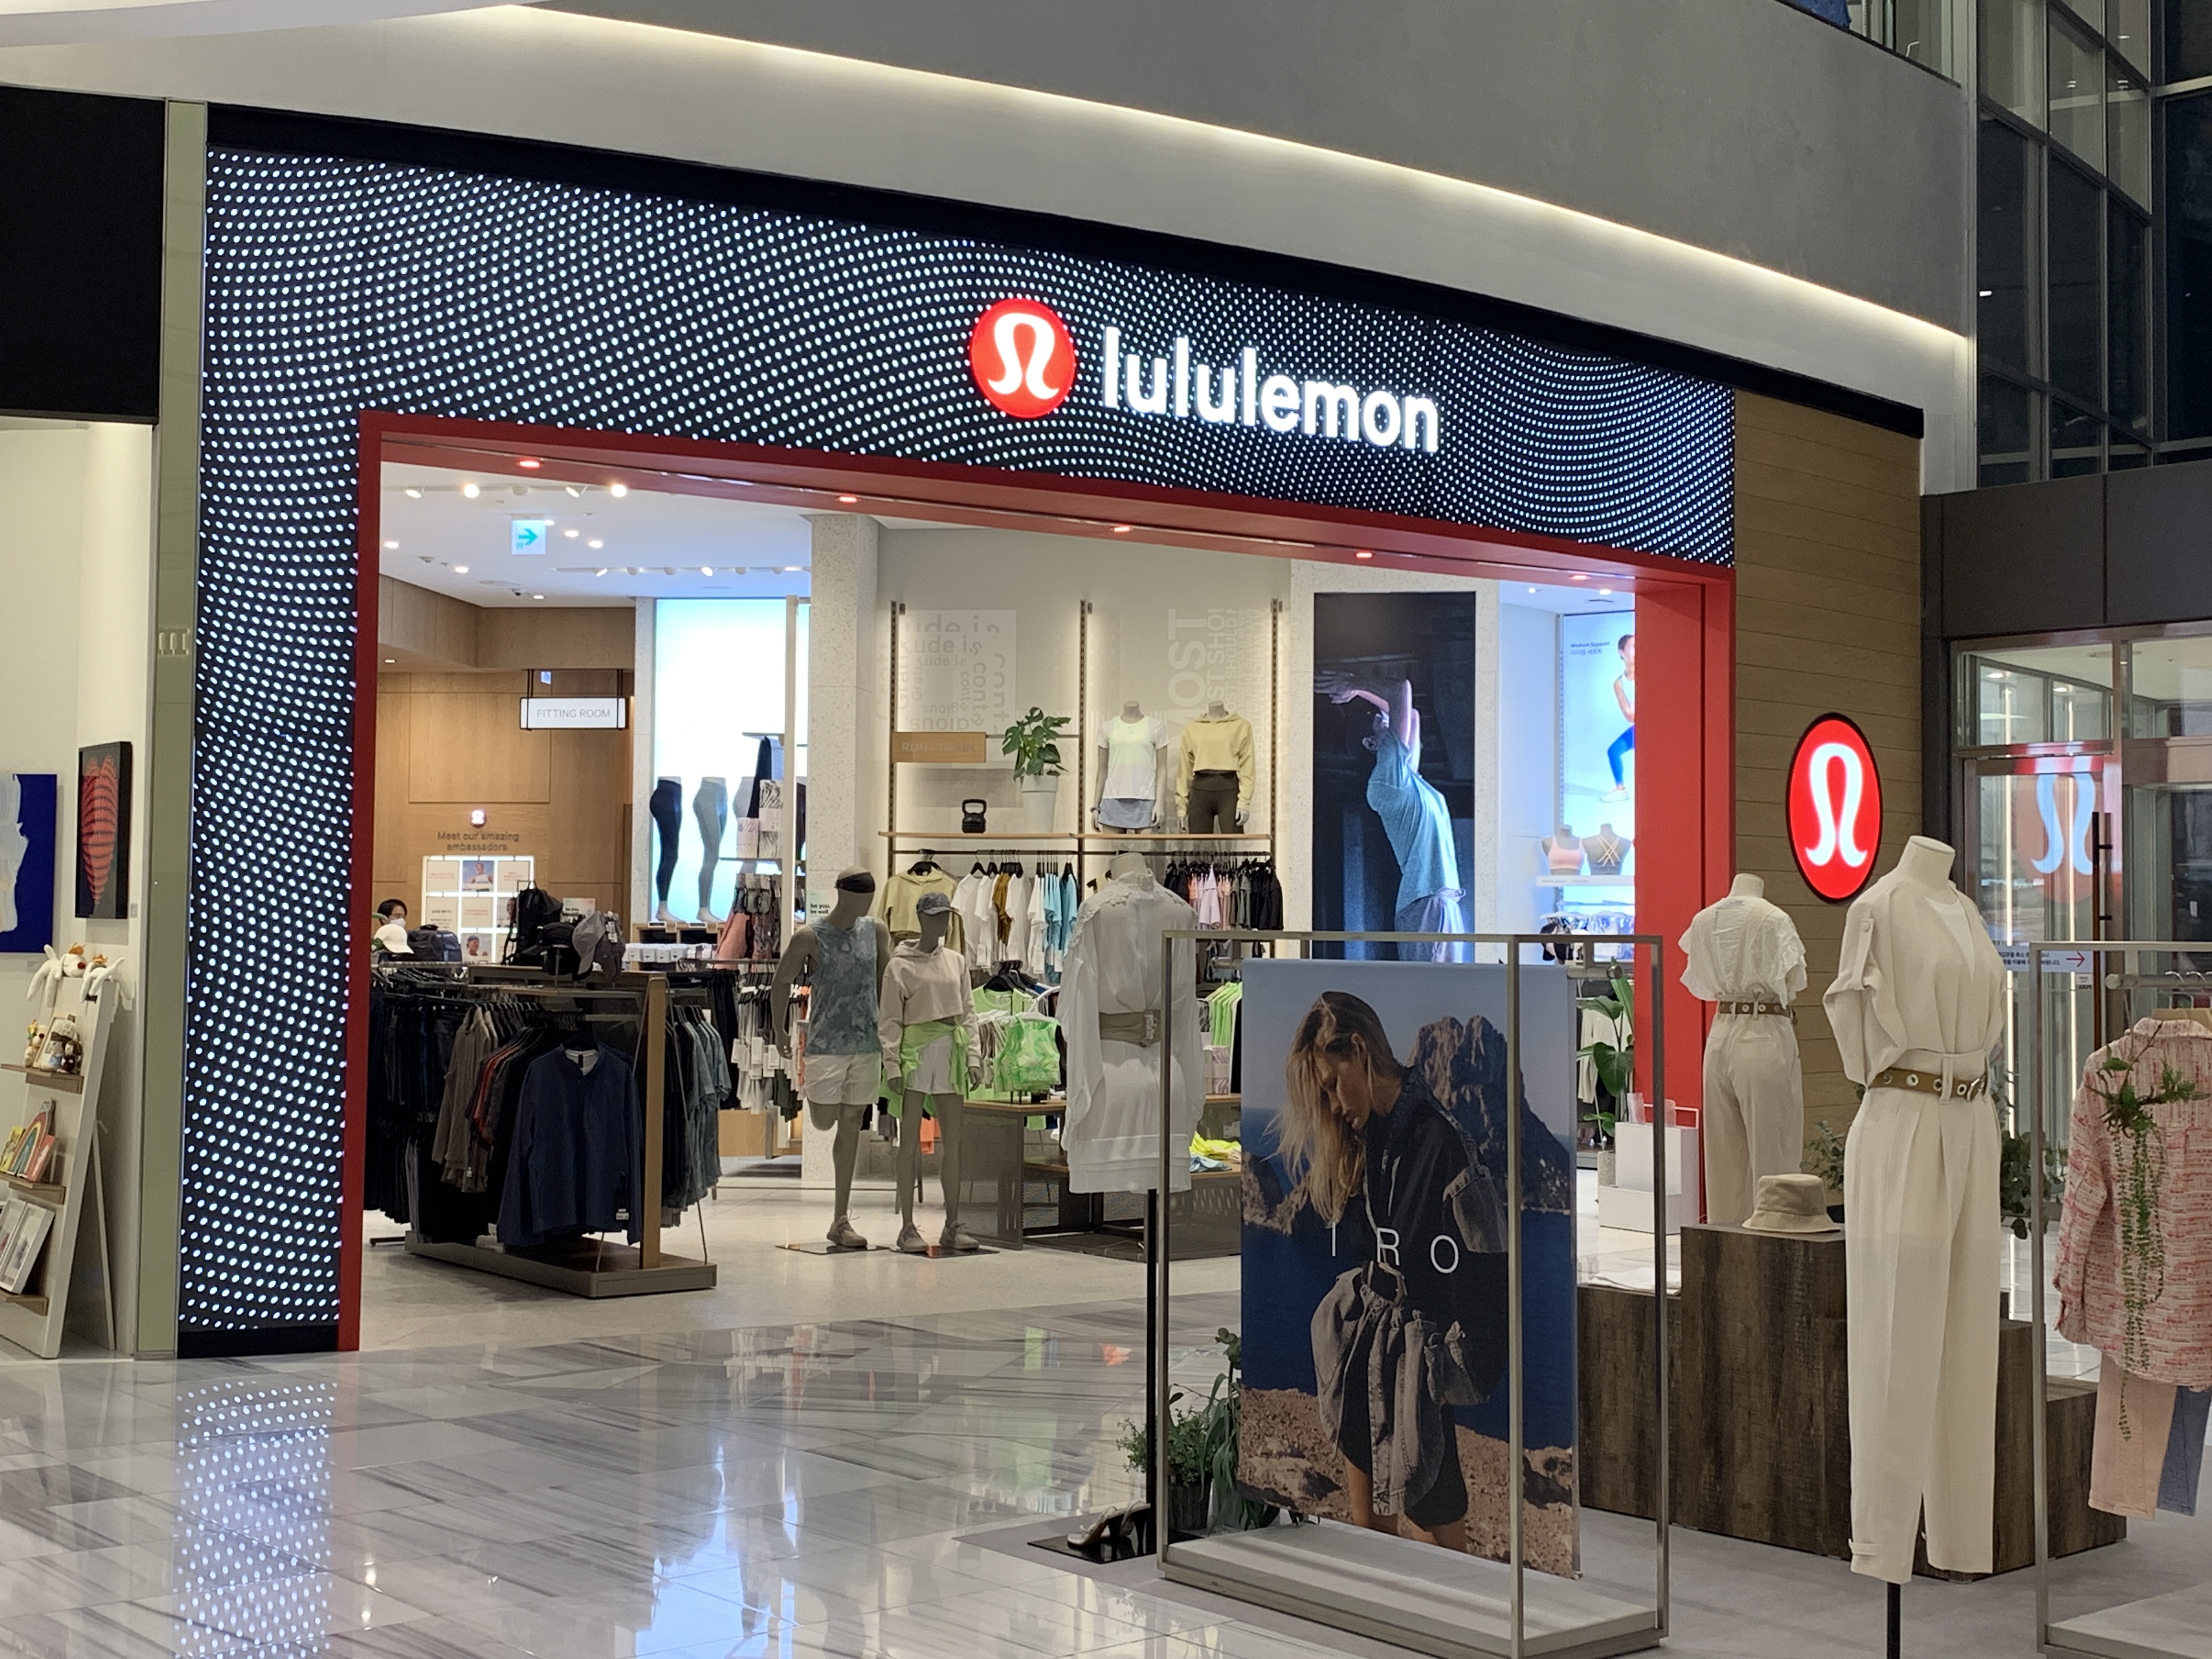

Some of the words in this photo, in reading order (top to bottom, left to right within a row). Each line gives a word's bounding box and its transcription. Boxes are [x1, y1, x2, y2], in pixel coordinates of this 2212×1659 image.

[1103, 326, 1439, 453] lululemon
[1225, 618, 1237, 679] SHOULD
[537, 709, 577, 718] FITTING
[579, 709, 611, 718] ROOM
[437, 832, 460, 840] Meet
[481, 832, 520, 842] amazing
[1331, 1221, 1460, 1274] IRO
